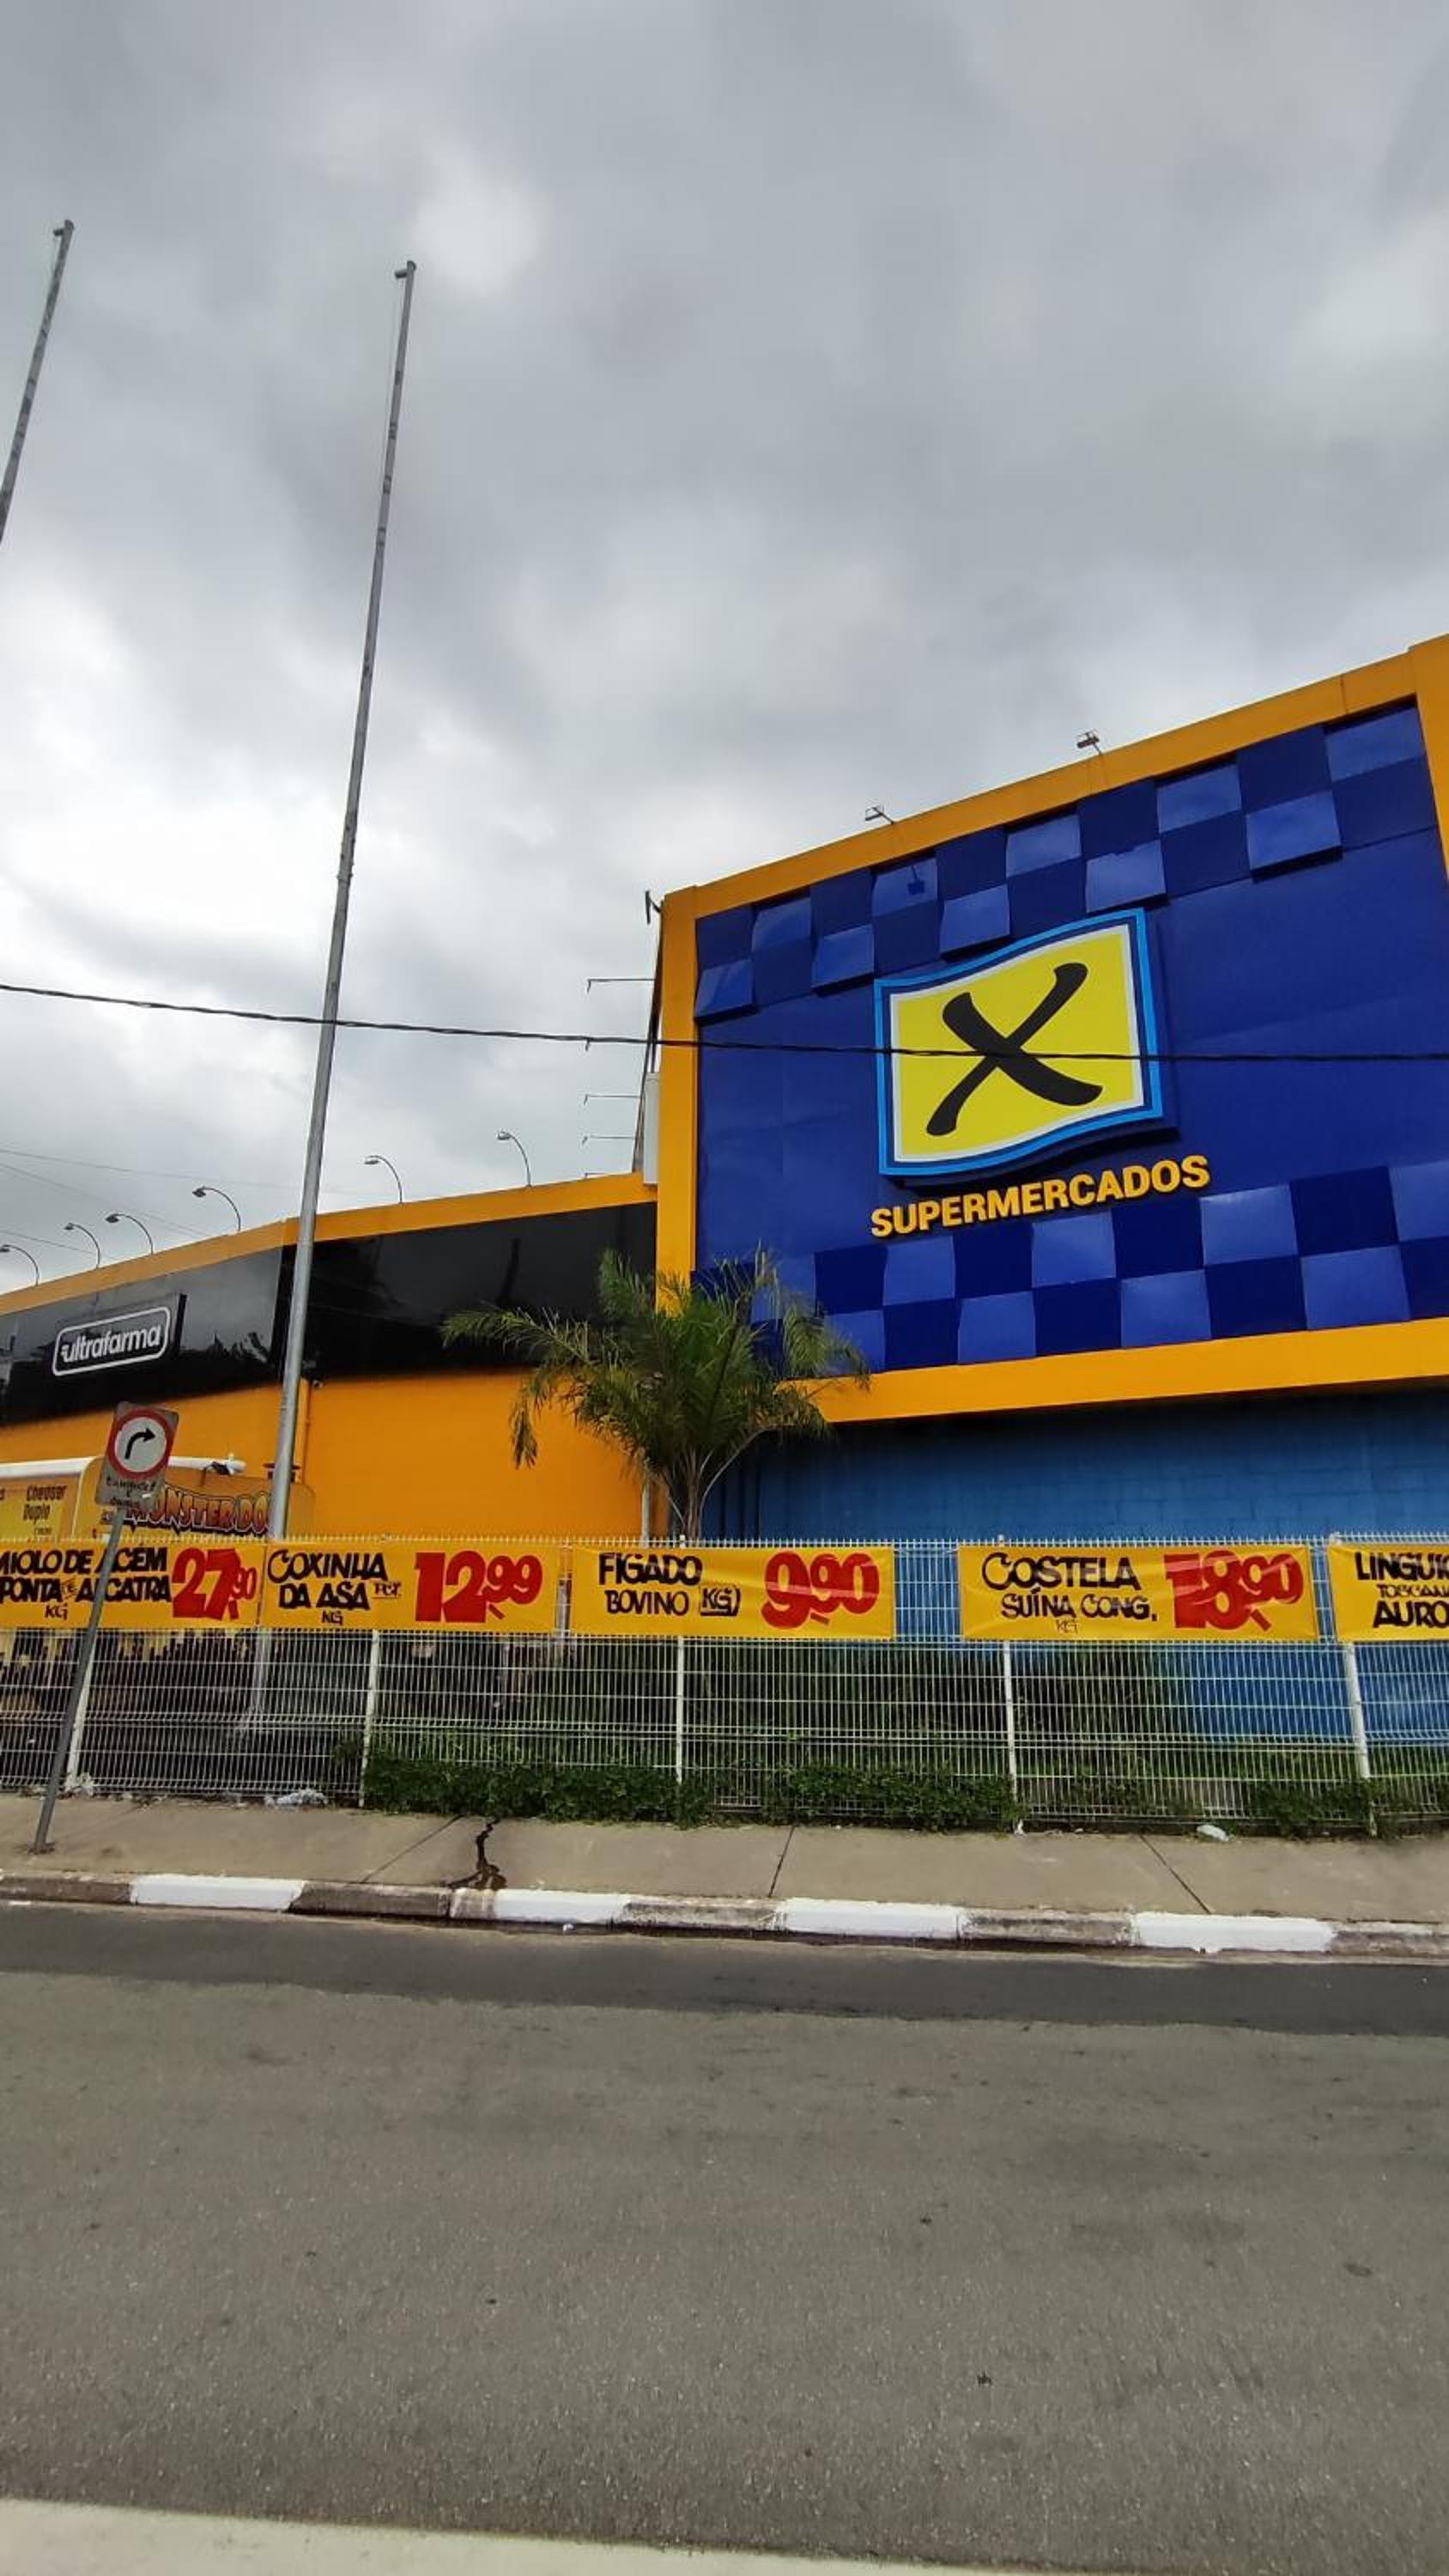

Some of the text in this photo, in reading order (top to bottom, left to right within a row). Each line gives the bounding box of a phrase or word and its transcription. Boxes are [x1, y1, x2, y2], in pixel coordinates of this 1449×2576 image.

[870, 1155, 1210, 1237] SUPERMERCADOS
[61, 1324, 161, 1364] ultrafarma
[64, 1549, 94, 1574] DE
[982, 1552, 1142, 1590] COSTELA
[0, 1577, 64, 1604] PONTA
[75, 1576, 172, 1602] ACATRA
[279, 1583, 312, 1608] DA
[316, 1581, 370, 1610] ASA
[604, 1589, 689, 1616] BOVINO
[1001, 1587, 1076, 1619] SUÍNA
[45, 1602, 68, 1621] KG
[1372, 1601, 1449, 1628] AURO
